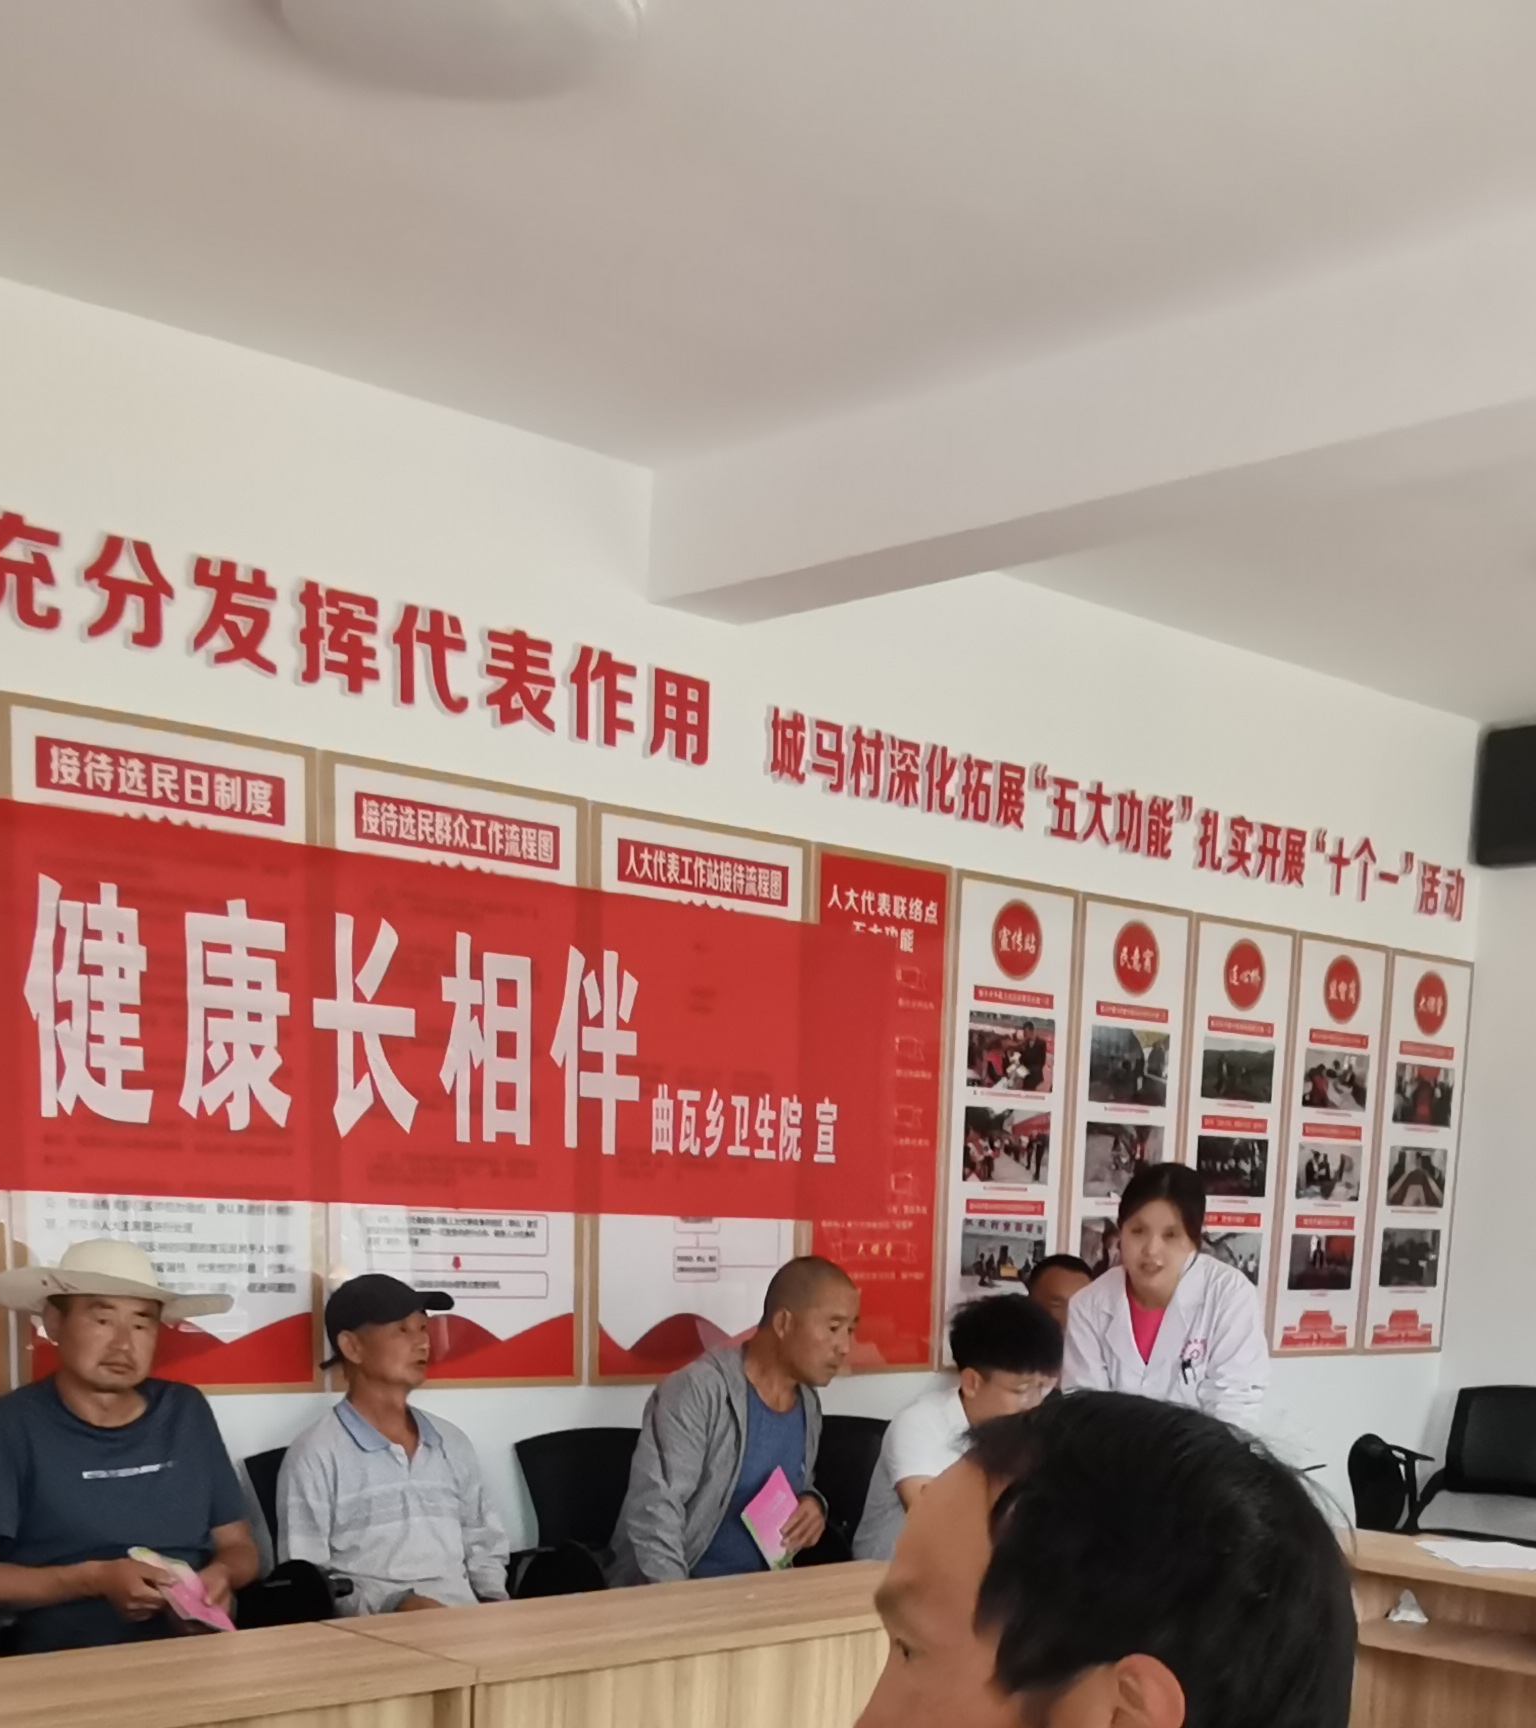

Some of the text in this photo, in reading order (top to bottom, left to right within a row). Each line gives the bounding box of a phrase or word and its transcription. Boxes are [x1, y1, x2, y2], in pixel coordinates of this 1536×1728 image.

[49, 747, 275, 820] 接待选民日制度
[362, 799, 555, 863] 接待选民群众工作流程图
[625, 846, 784, 900] 人大代表工作站接待流程图
[828, 884, 938, 925] 人大代表联络点
[23, 872, 641, 1154] 健康长相伴
[651, 1085, 839, 1164] 曲瓦乡卫生院 宣
